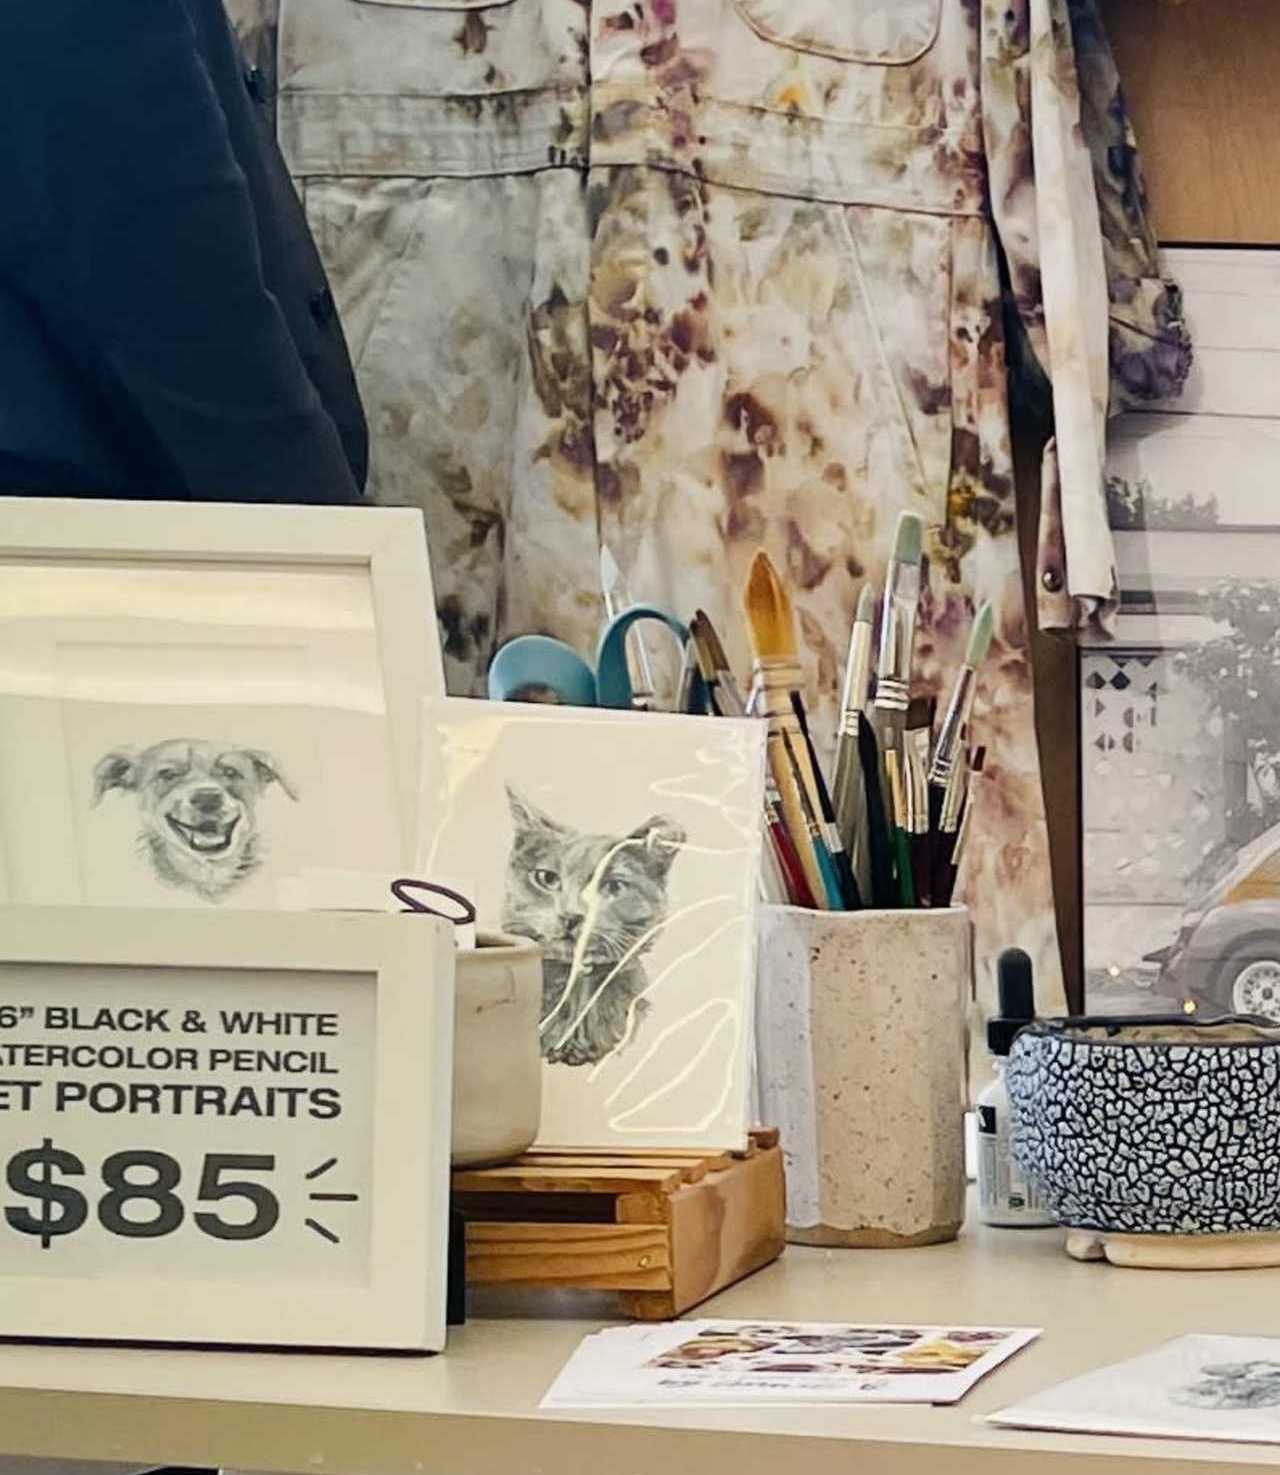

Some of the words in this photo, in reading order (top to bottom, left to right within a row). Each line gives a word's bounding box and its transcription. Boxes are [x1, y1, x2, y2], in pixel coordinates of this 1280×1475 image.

[44, 1006, 171, 1033] BLACK
[181, 1010, 207, 1034] &
[219, 1010, 339, 1037] WHITE
[0, 1043, 198, 1071] TERCOLOR
[209, 1048, 339, 1074] PENCIL
[55, 1081, 342, 1120] PORTRAITS
[4, 1138, 280, 1250] $85
